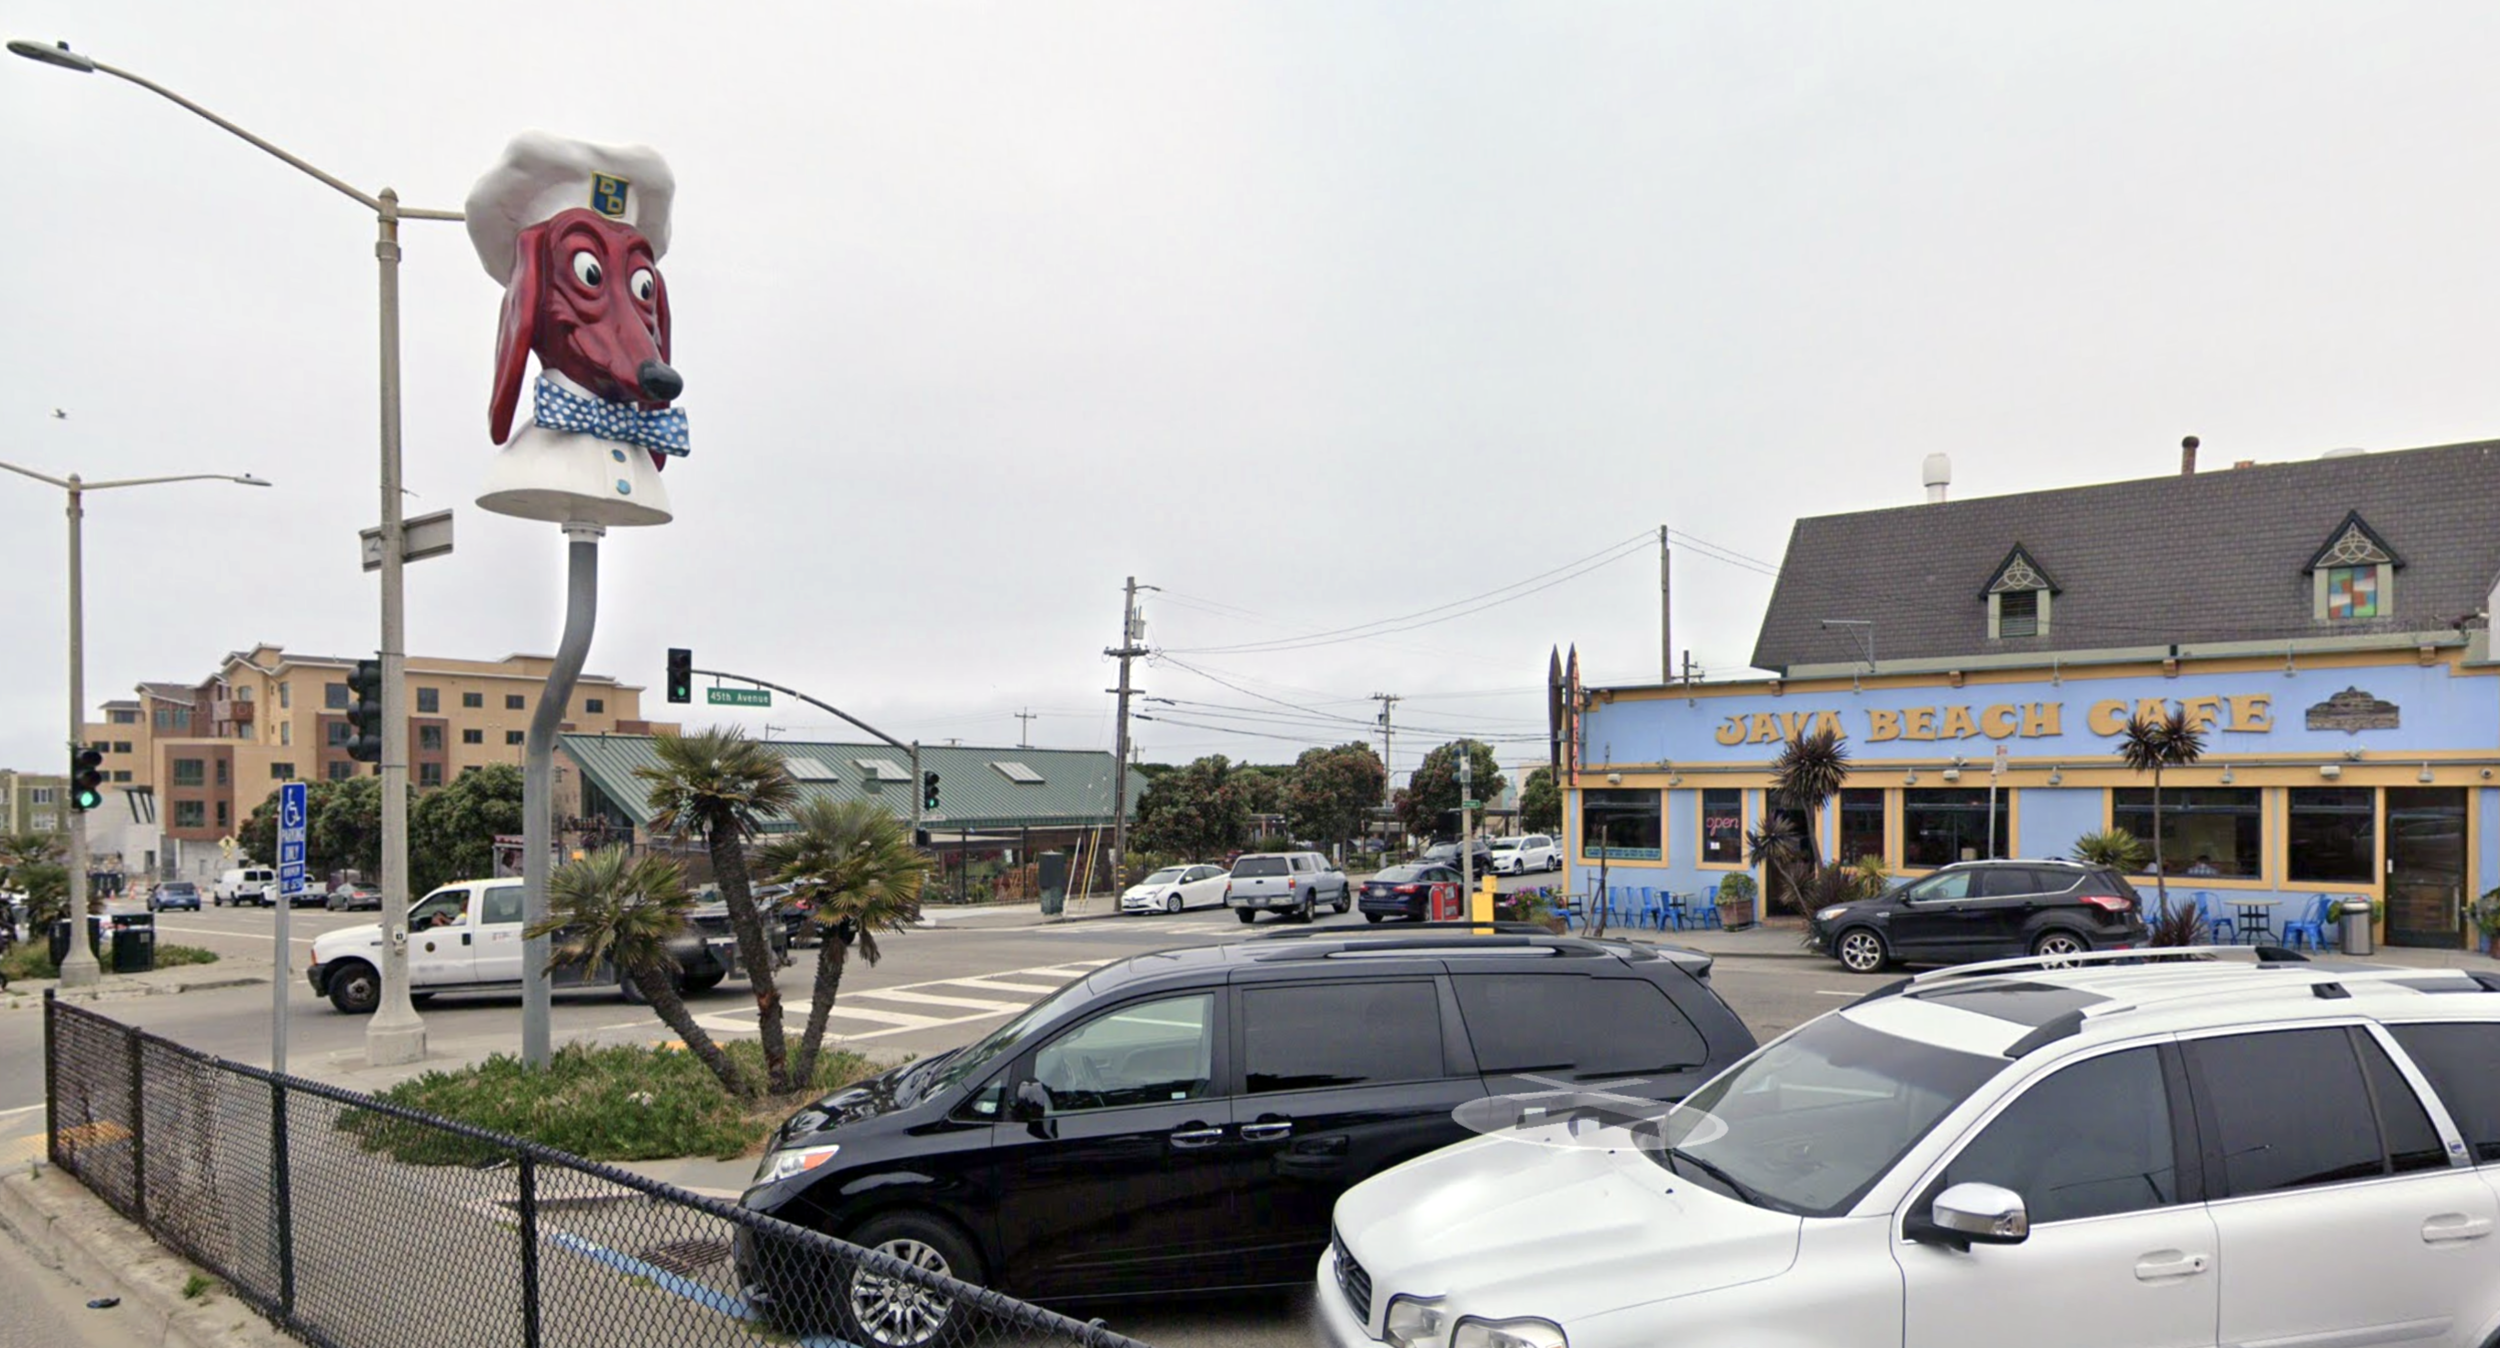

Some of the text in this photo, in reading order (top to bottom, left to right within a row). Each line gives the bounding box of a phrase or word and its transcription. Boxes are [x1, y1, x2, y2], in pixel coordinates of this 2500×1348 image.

[710, 690, 769, 704] 45th Avenue
[1715, 693, 2275, 745] JAVA BEACH CAFE
[1706, 816, 1739, 836] open
